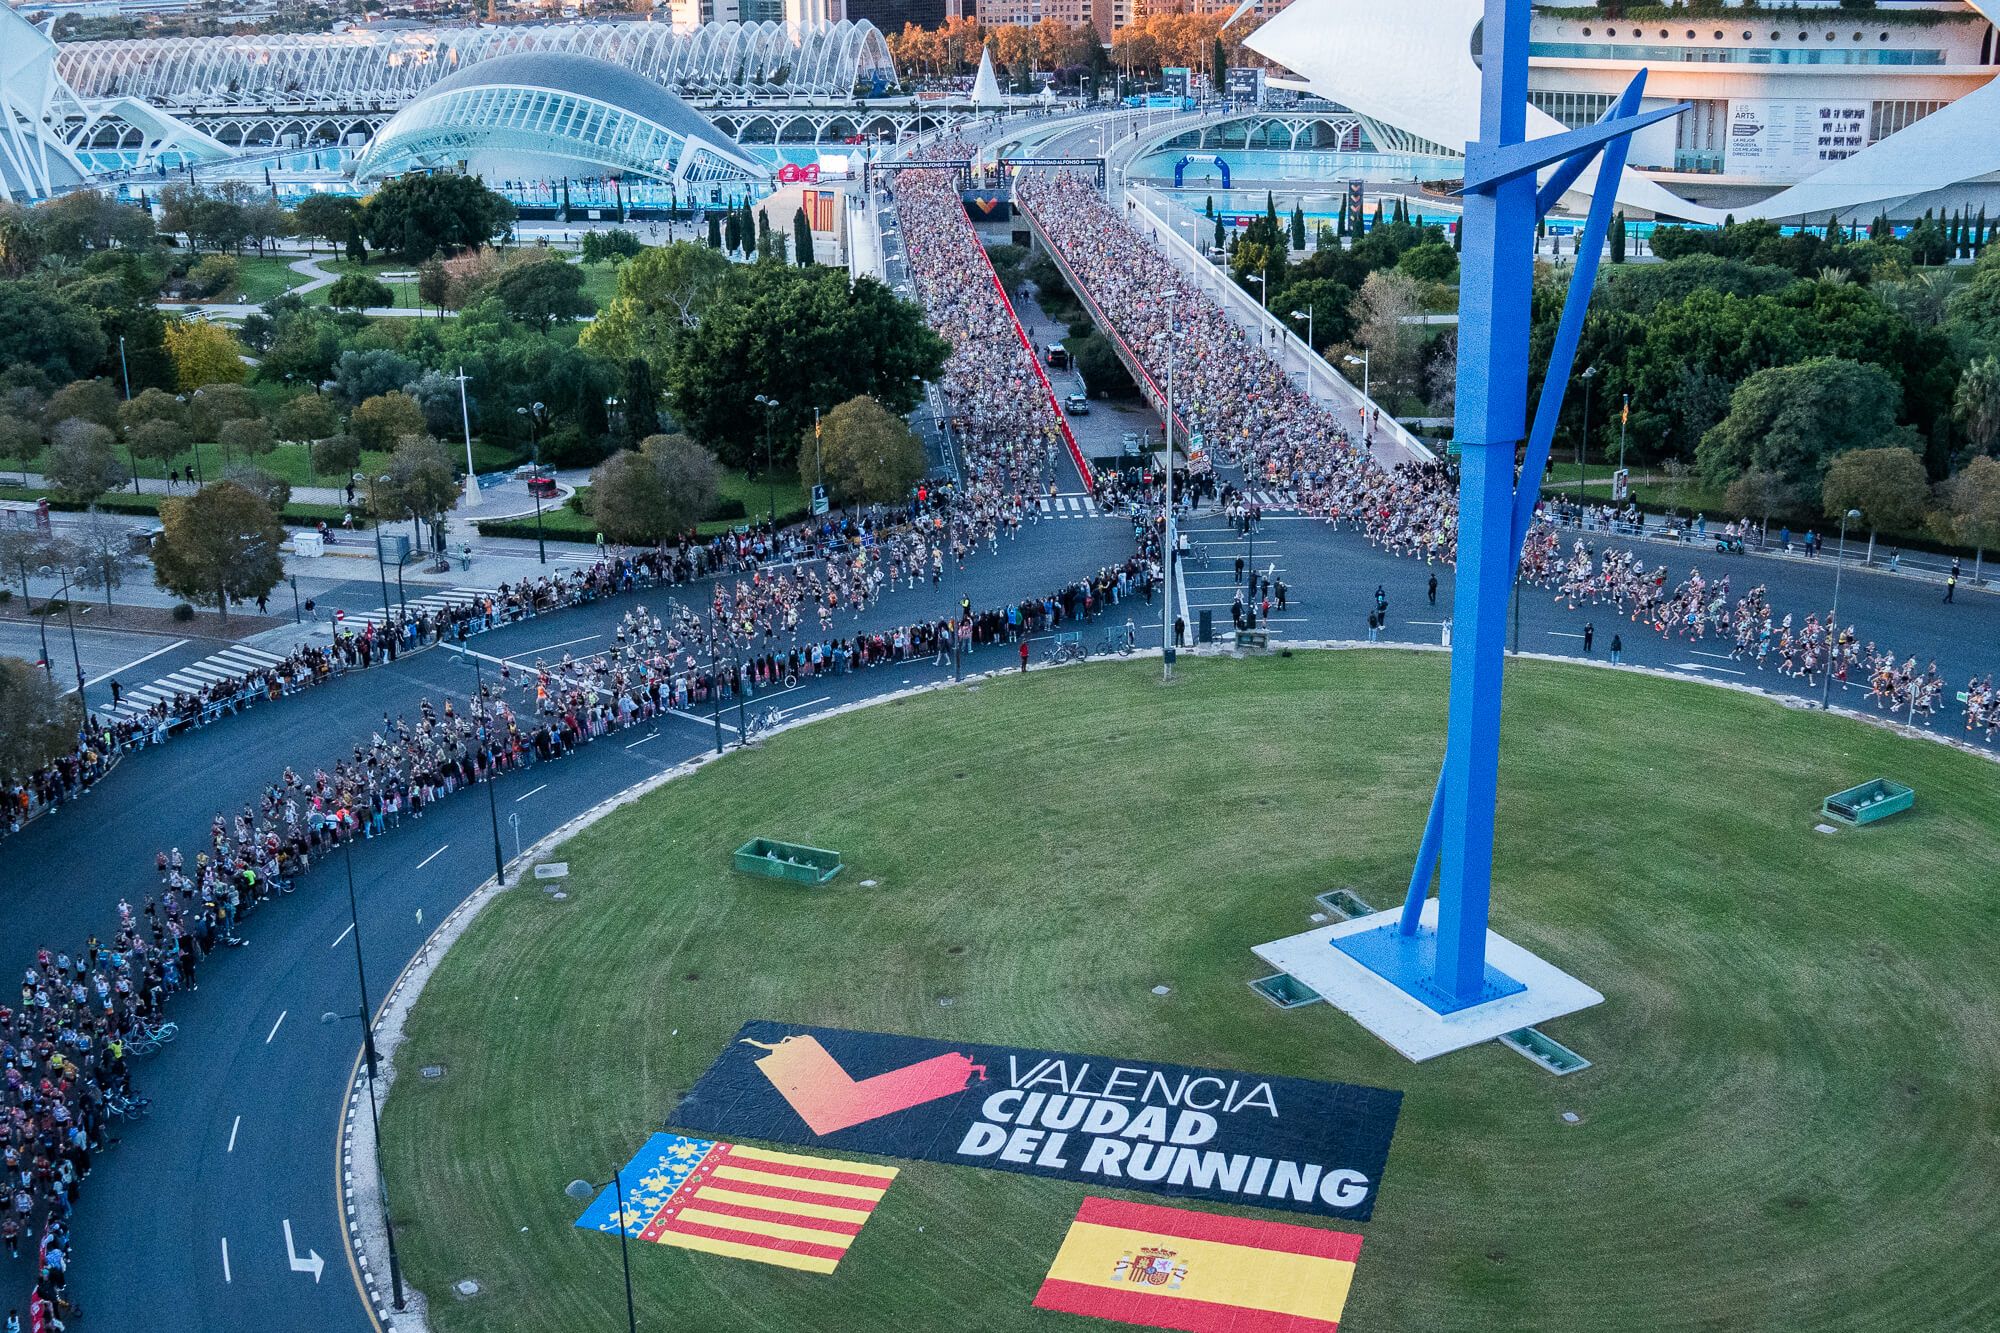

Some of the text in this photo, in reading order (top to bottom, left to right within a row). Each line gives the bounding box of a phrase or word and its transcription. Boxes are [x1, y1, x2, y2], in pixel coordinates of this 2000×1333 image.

[1735, 104, 1750, 112] LES
[1009, 1055, 1279, 1117] VALENCIA
[981, 1089, 1218, 1145] CIUDAD
[957, 1121, 1369, 1207] DEL RUNNING
